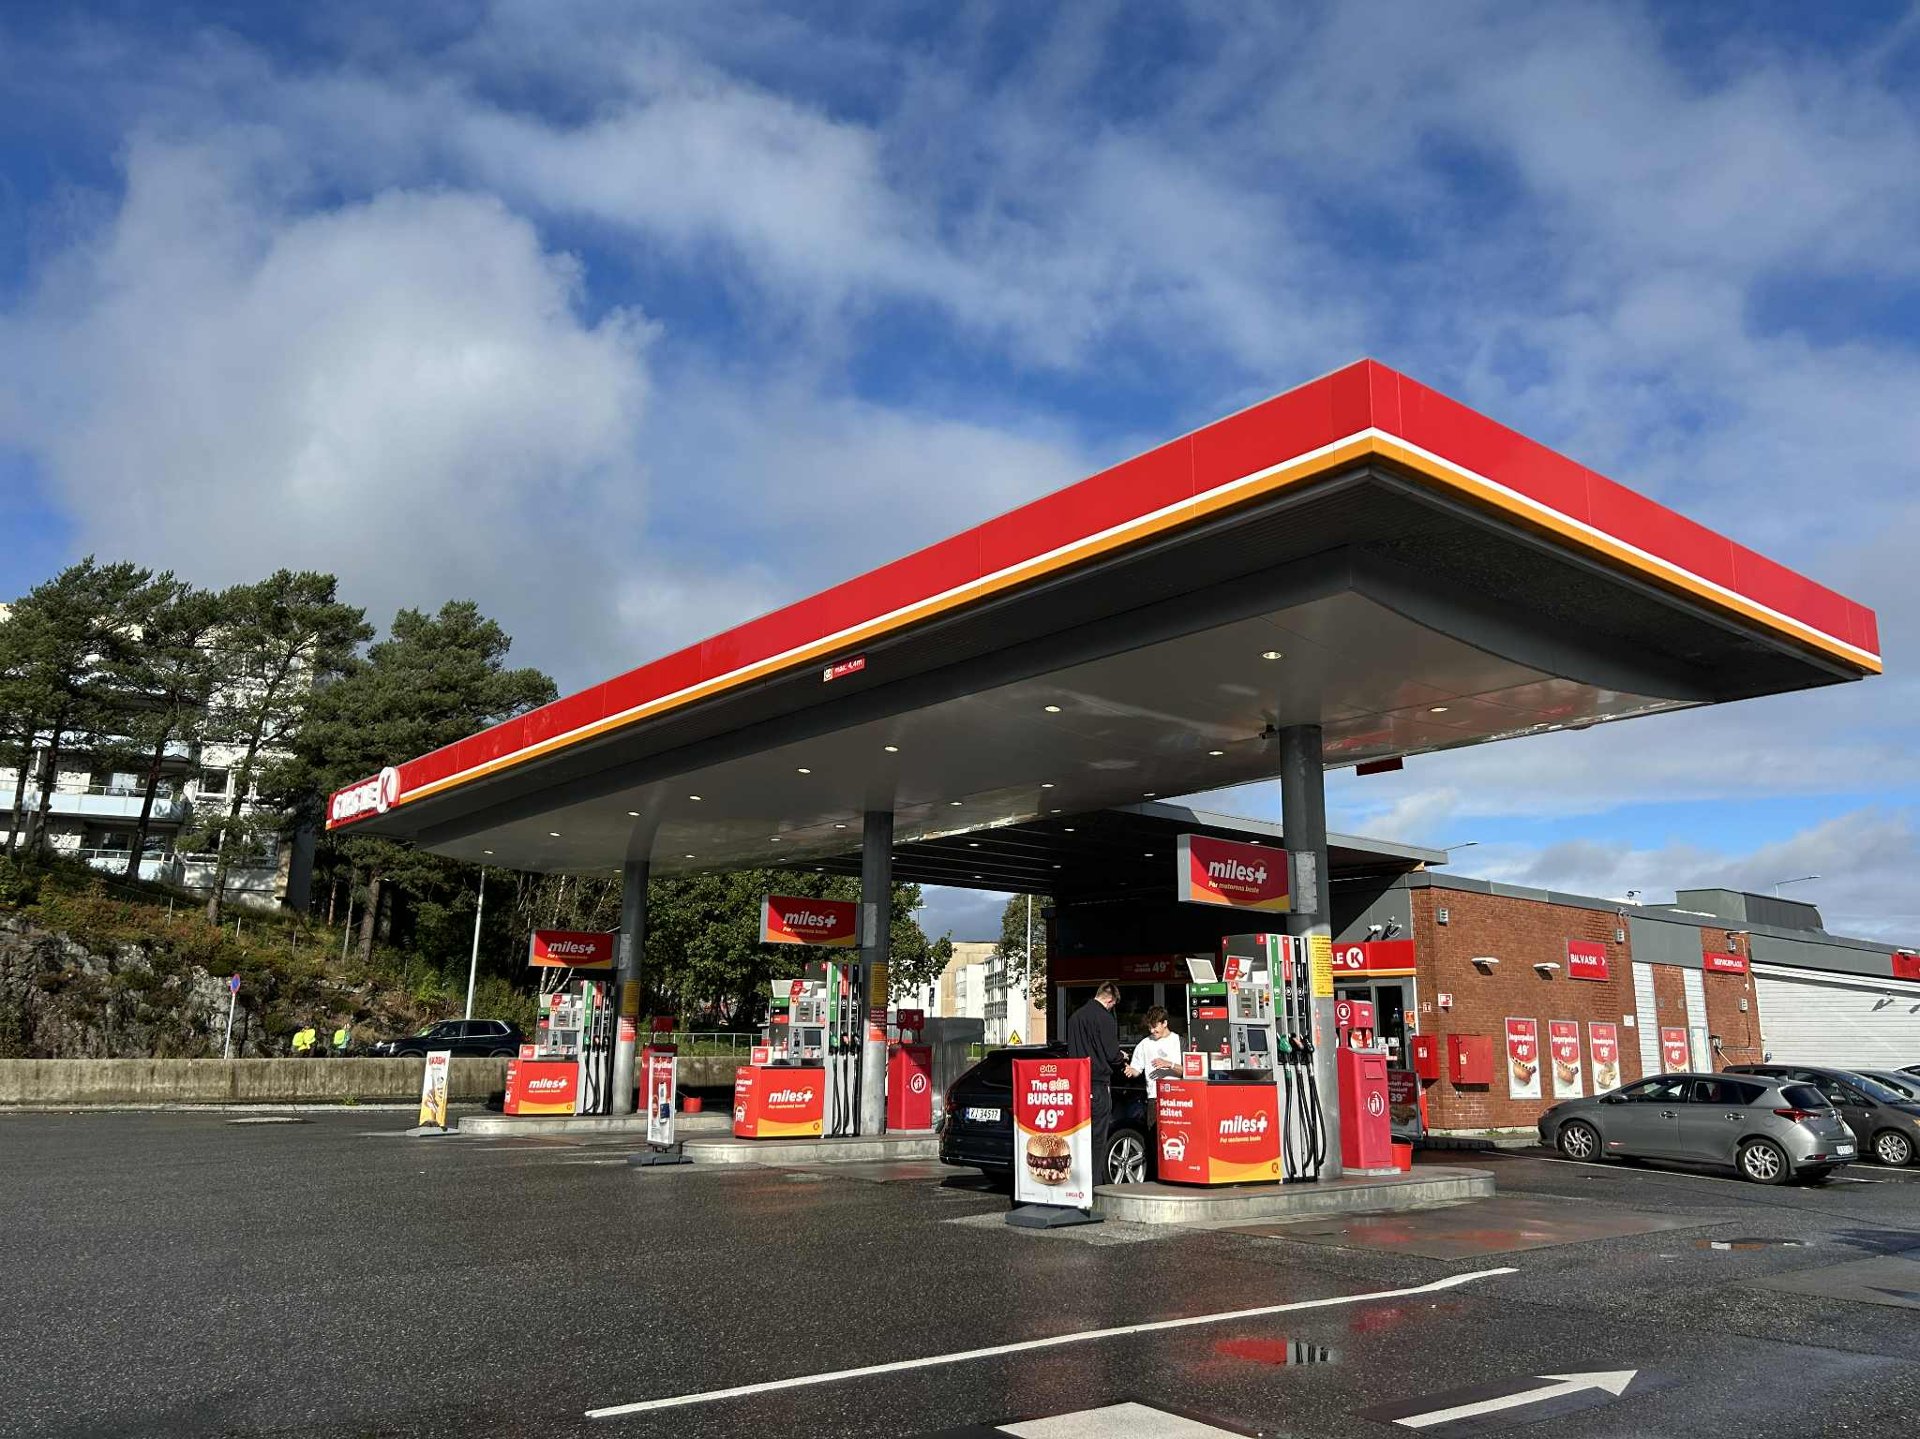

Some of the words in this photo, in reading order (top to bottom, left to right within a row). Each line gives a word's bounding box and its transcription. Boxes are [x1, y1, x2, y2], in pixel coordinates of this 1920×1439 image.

[1208, 859, 1267, 884] miles+
[783, 911, 837, 928] miles+
[547, 941, 596, 955] miles+
[1570, 953, 1598, 966] BILVASK
[528, 1078, 568, 1089] miles+
[1030, 1080, 1048, 1091] The
[768, 1089, 814, 1103] miles+
[1027, 1093, 1073, 1105] BURGER
[1219, 1115, 1268, 1134] miles+
